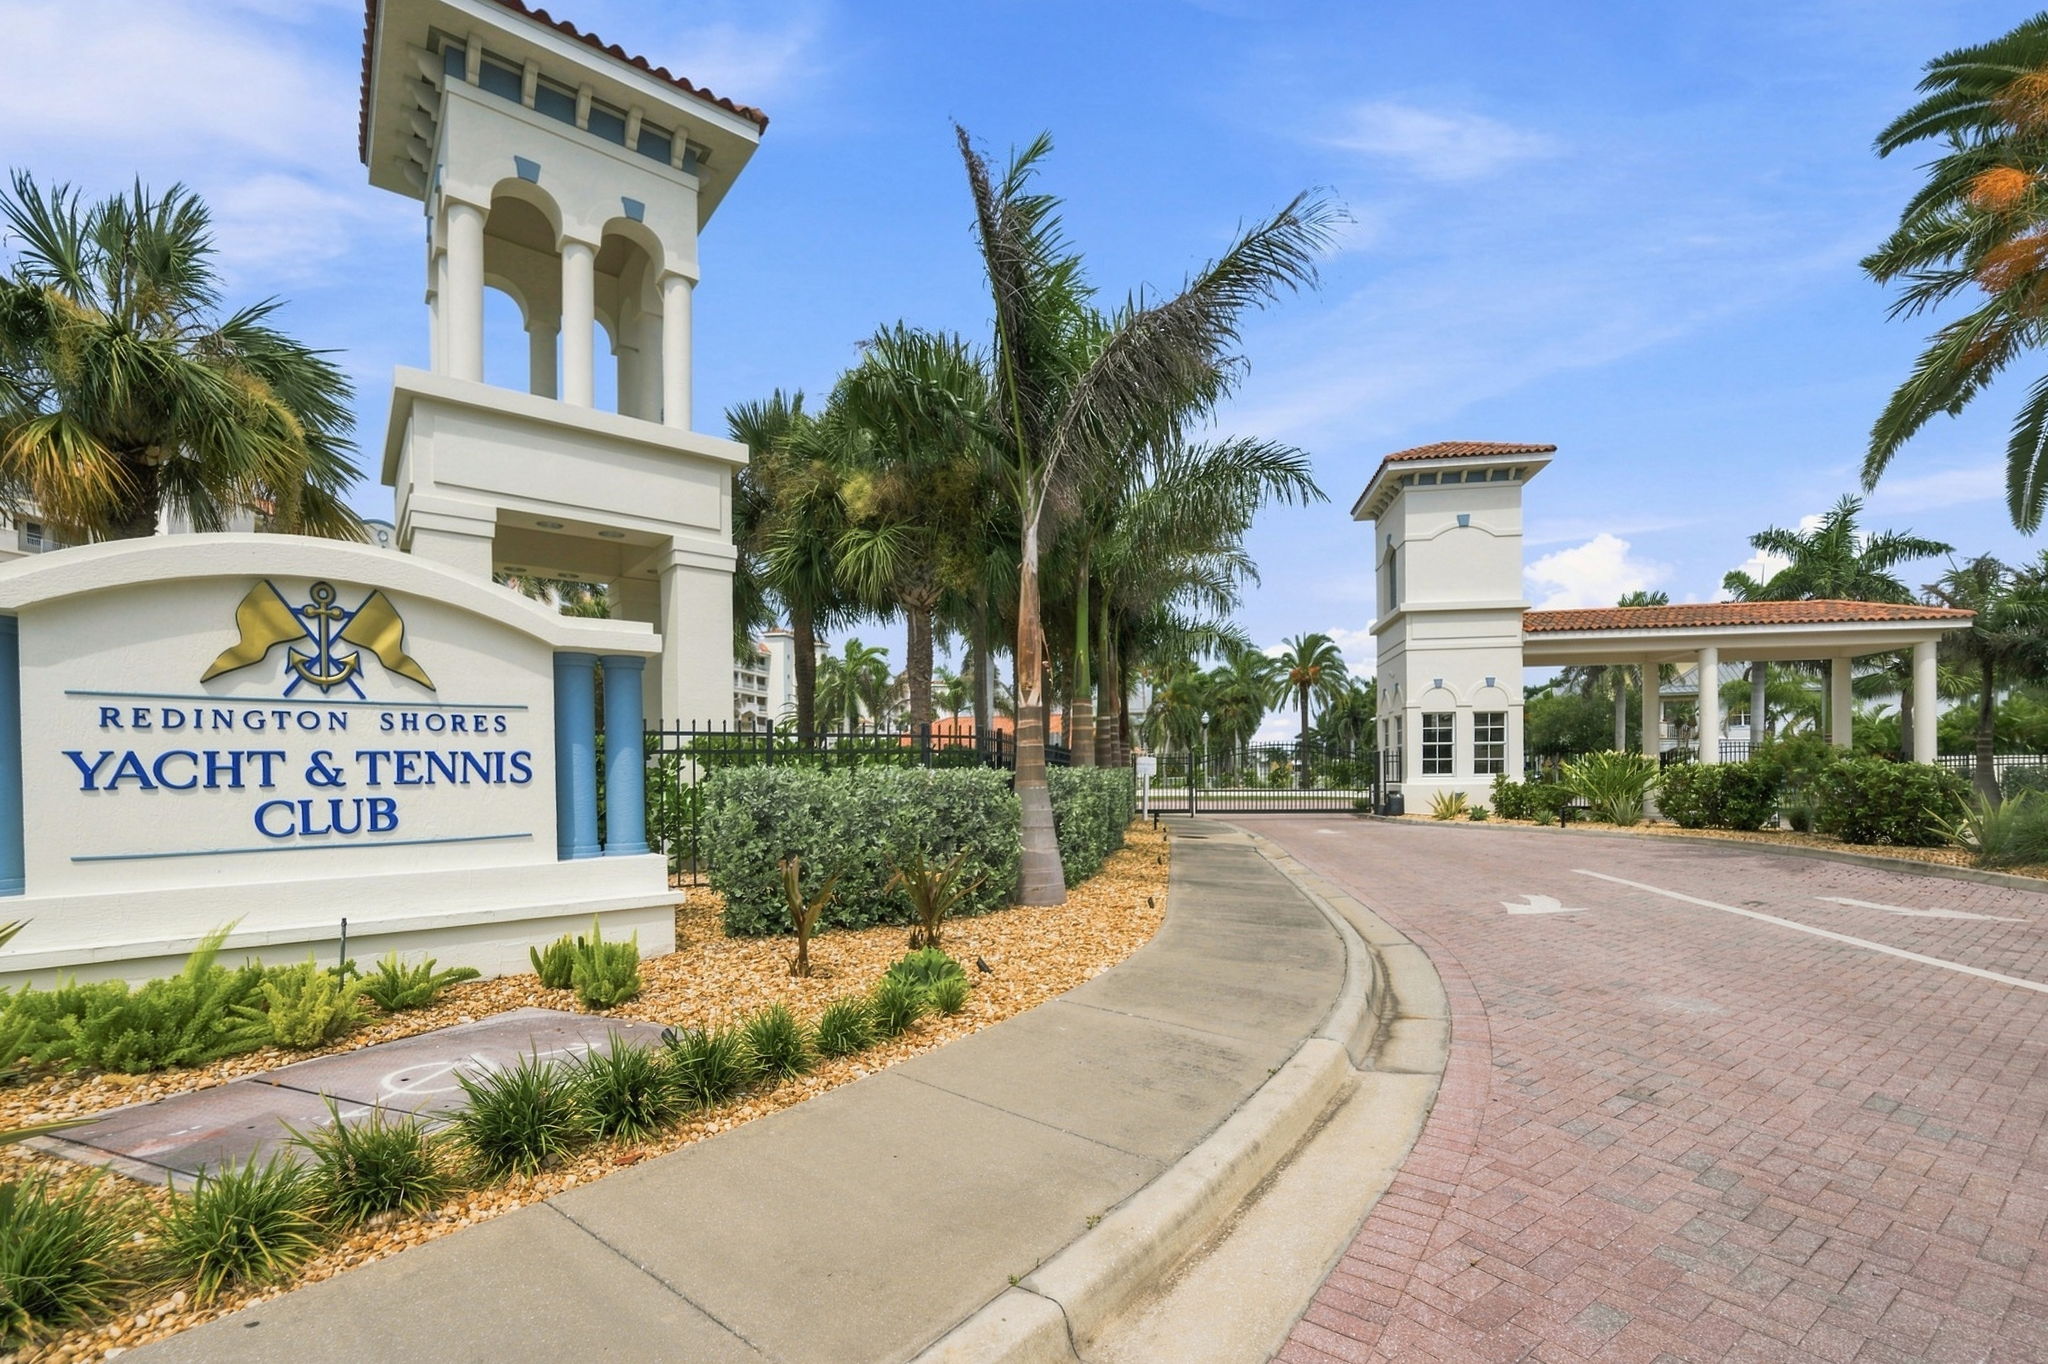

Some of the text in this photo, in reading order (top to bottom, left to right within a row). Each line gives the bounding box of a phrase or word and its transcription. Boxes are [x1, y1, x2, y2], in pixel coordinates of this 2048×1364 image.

[98, 705, 508, 733] REDINGTON SHORES
[63, 749, 533, 791] YACHT & TENNIS
[254, 797, 399, 838] CLUB
